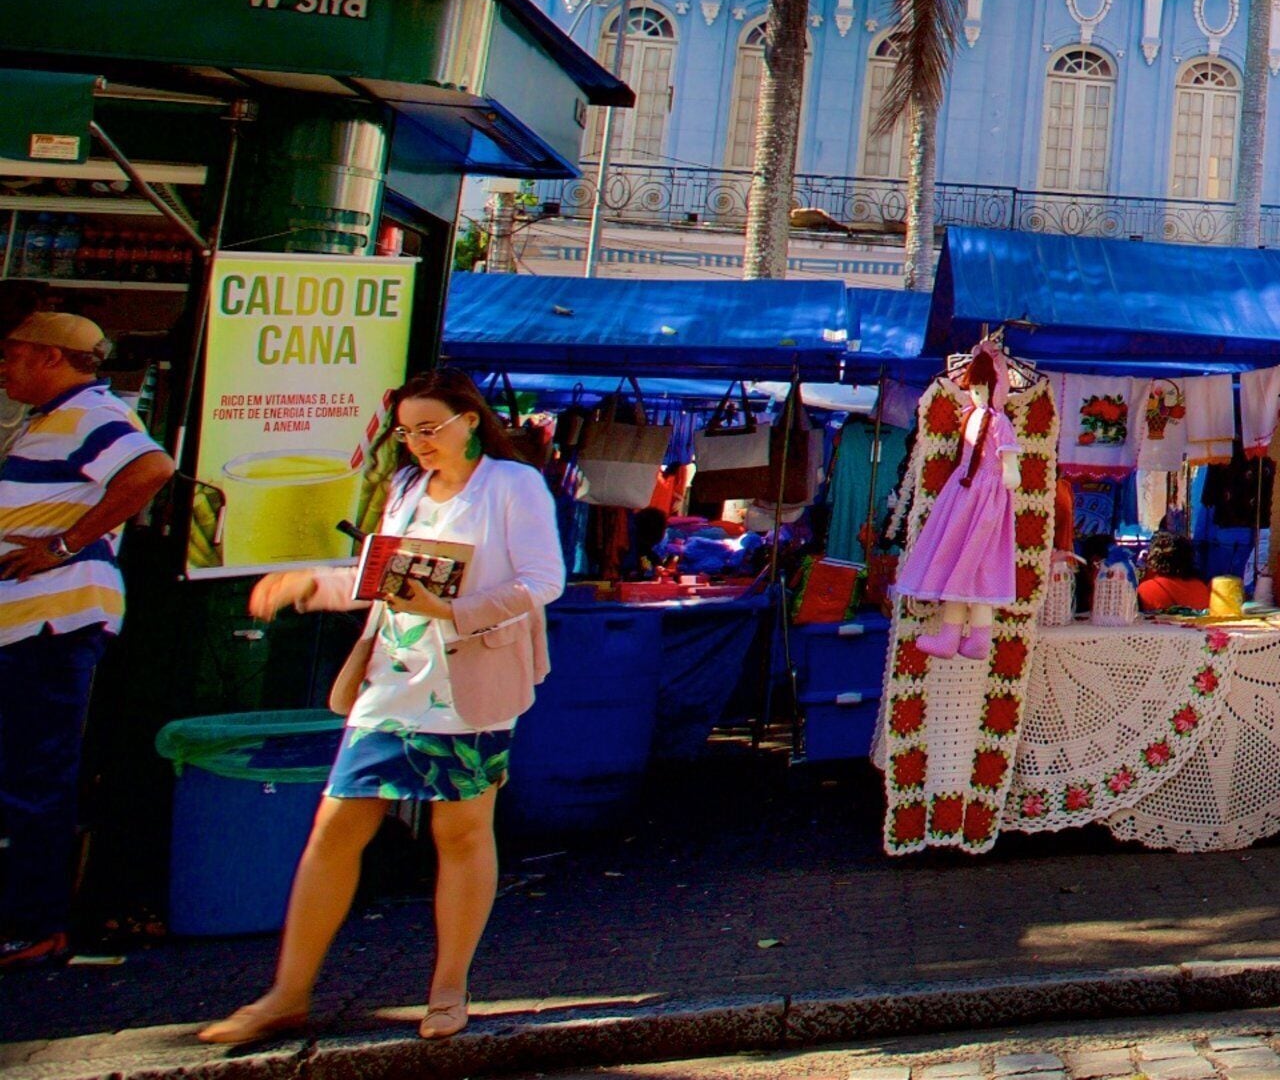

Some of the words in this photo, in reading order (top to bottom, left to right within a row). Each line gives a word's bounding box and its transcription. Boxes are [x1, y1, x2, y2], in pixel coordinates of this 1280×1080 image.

[220, 275, 345, 317] CALDO
[355, 278, 402, 317] DE
[257, 324, 357, 365] CANA
[220, 394, 244, 407] RICO
[247, 394, 262, 406] EM
[265, 393, 318, 406] VITAMINAS
[331, 393, 338, 405] C
[340, 393, 345, 404] E
[347, 393, 355, 404] A
[213, 408, 245, 420] FONTE
[248, 408, 261, 419] DE
[263, 407, 305, 419] ENERGIA
[307, 407, 313, 418] E
[315, 406, 360, 418] COMBATE
[263, 421, 271, 432] A
[273, 421, 311, 432] ANEMIA
